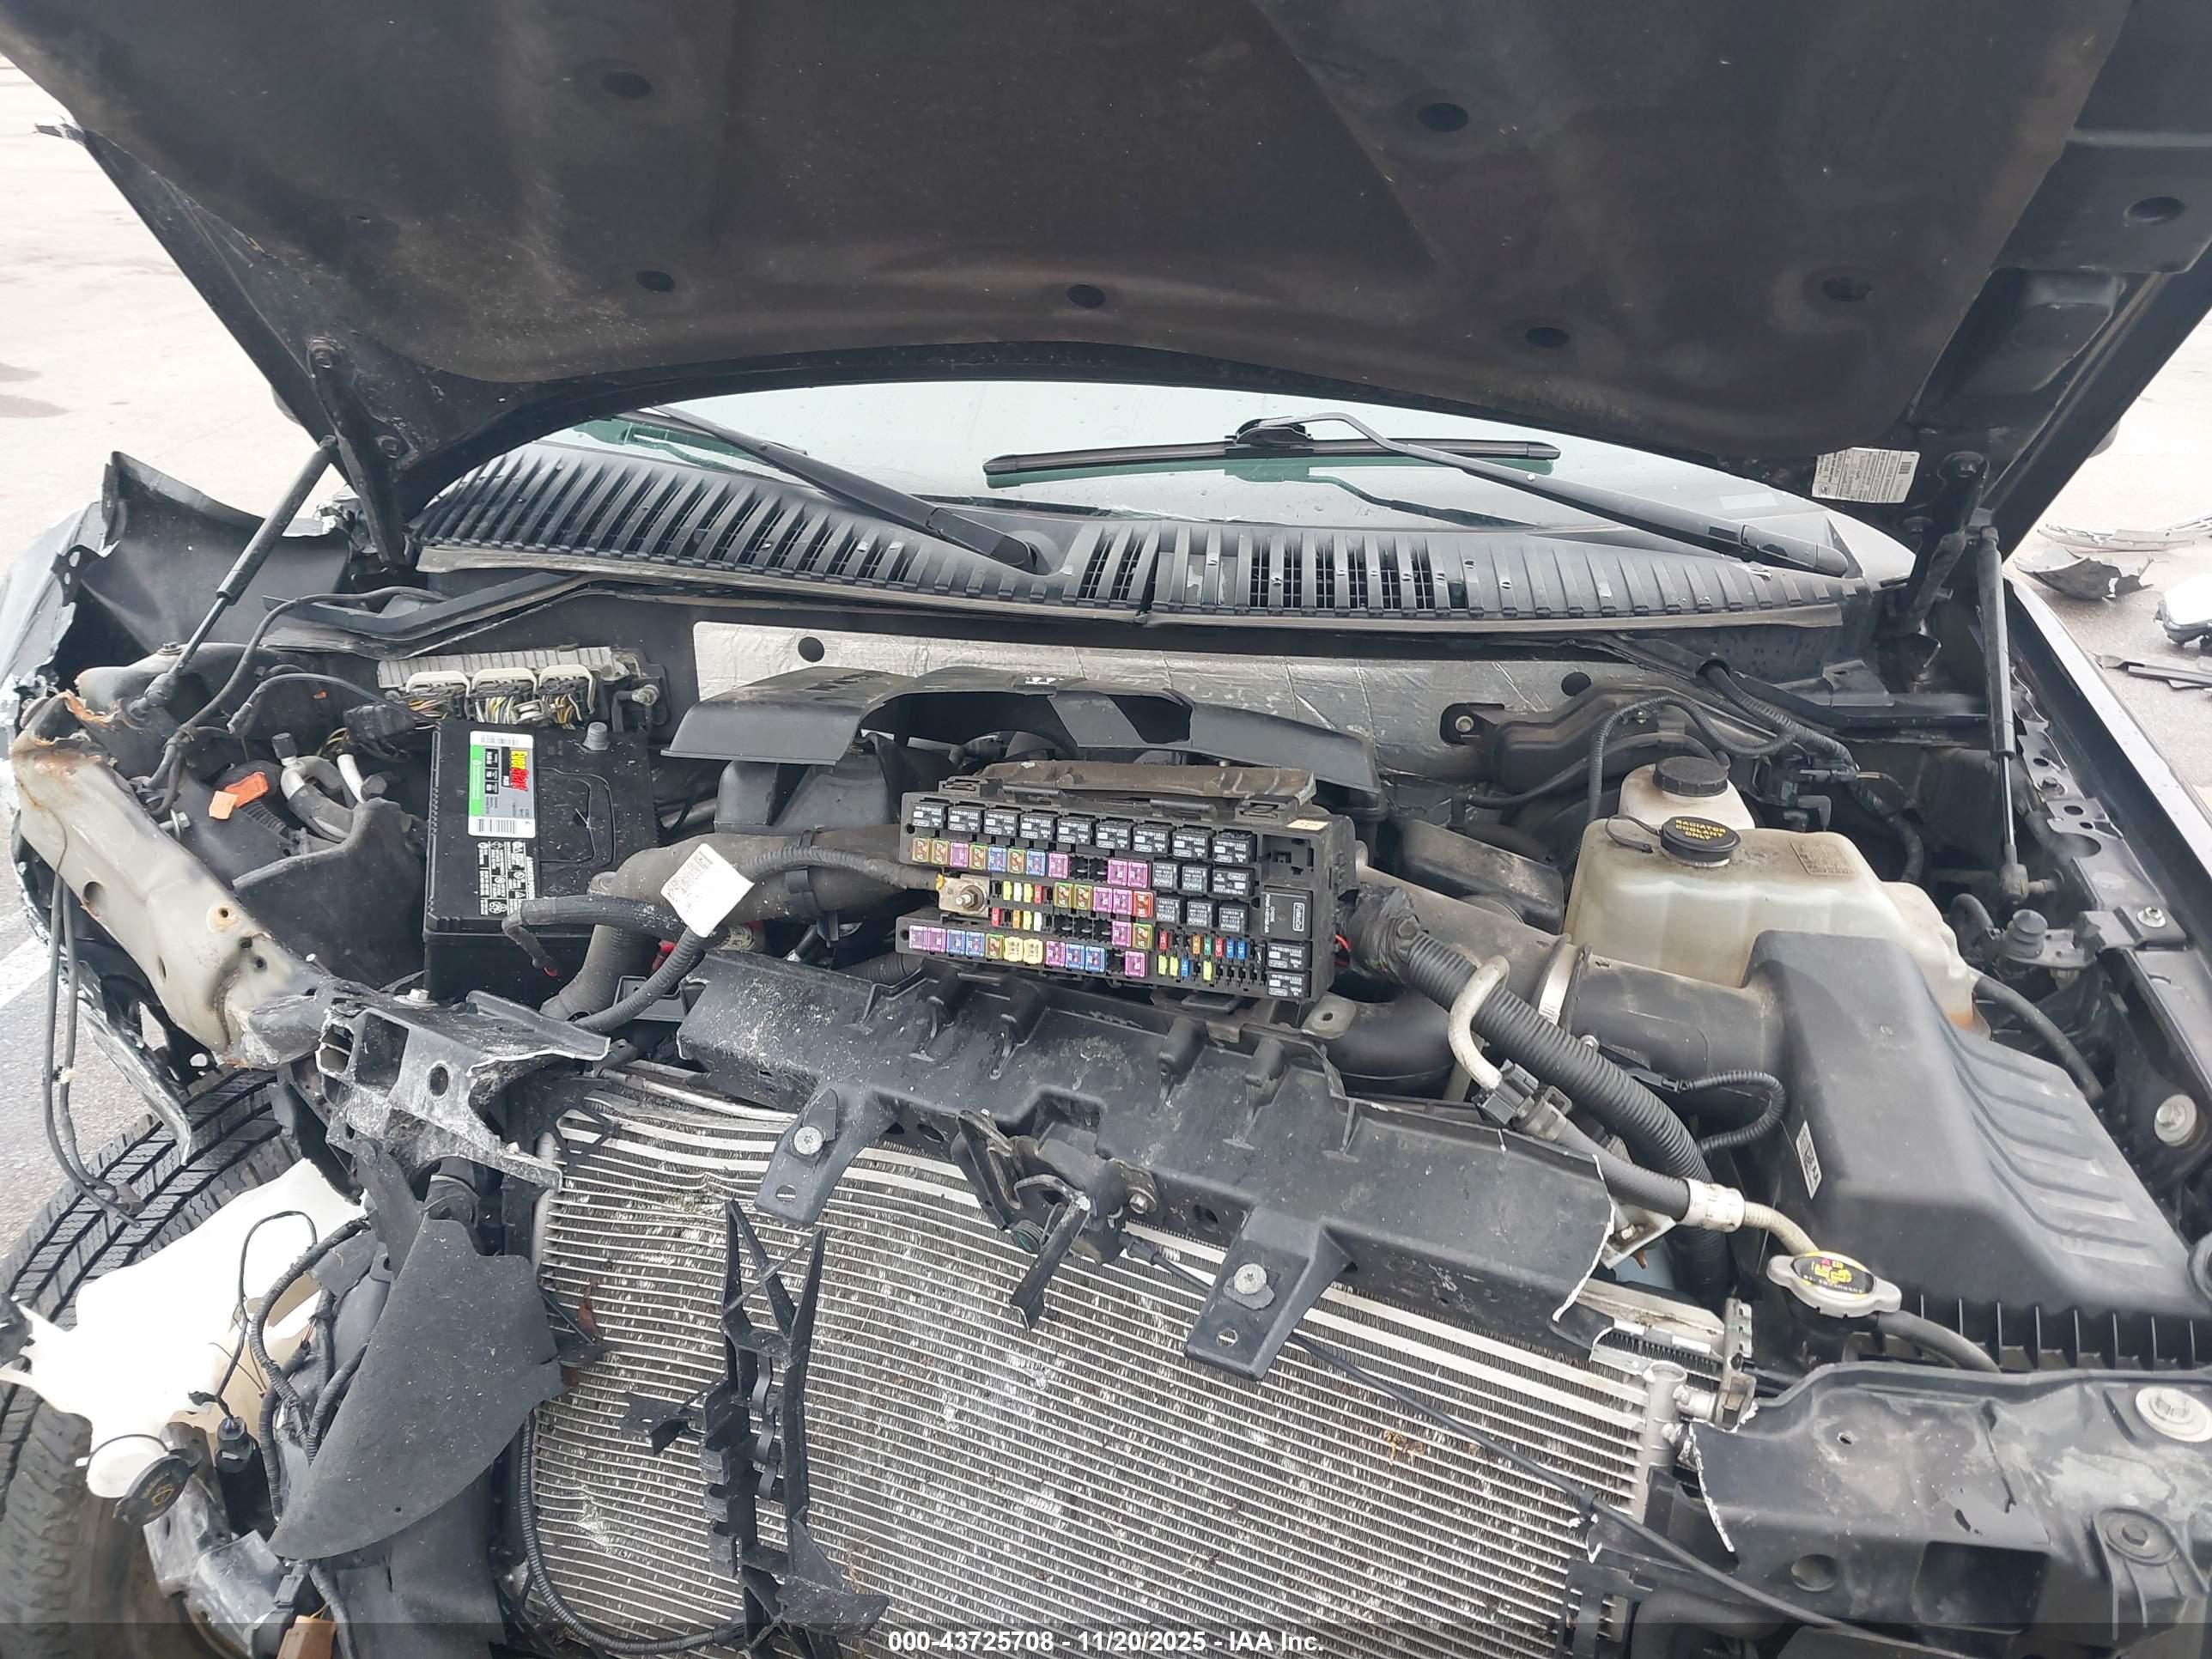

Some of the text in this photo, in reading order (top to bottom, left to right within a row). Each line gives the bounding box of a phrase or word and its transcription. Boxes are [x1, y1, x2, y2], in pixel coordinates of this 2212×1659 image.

[1675, 819, 1726, 834] RADIATOR
[1675, 824, 1723, 838] COOLANT
[1685, 831, 1711, 841] ONLY
